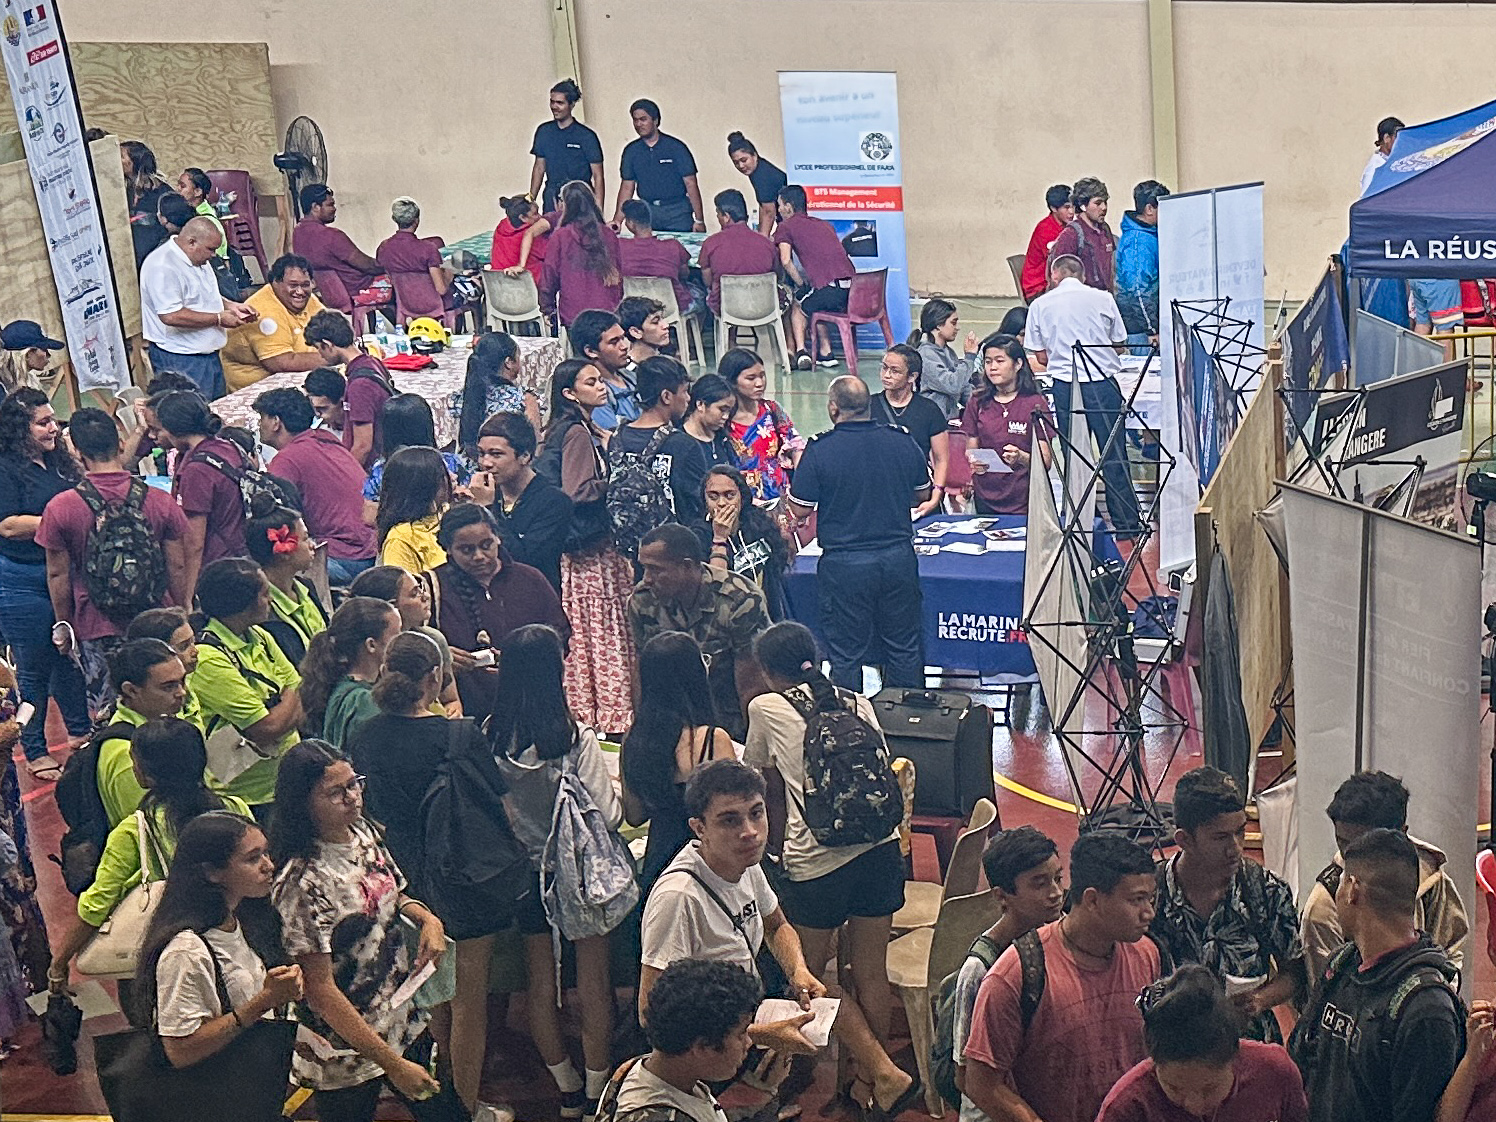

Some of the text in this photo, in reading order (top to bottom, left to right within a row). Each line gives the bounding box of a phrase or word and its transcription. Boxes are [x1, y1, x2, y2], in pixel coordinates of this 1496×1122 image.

[1384, 239, 1418, 259] LA
[938, 613, 1021, 631] LA MARIN
